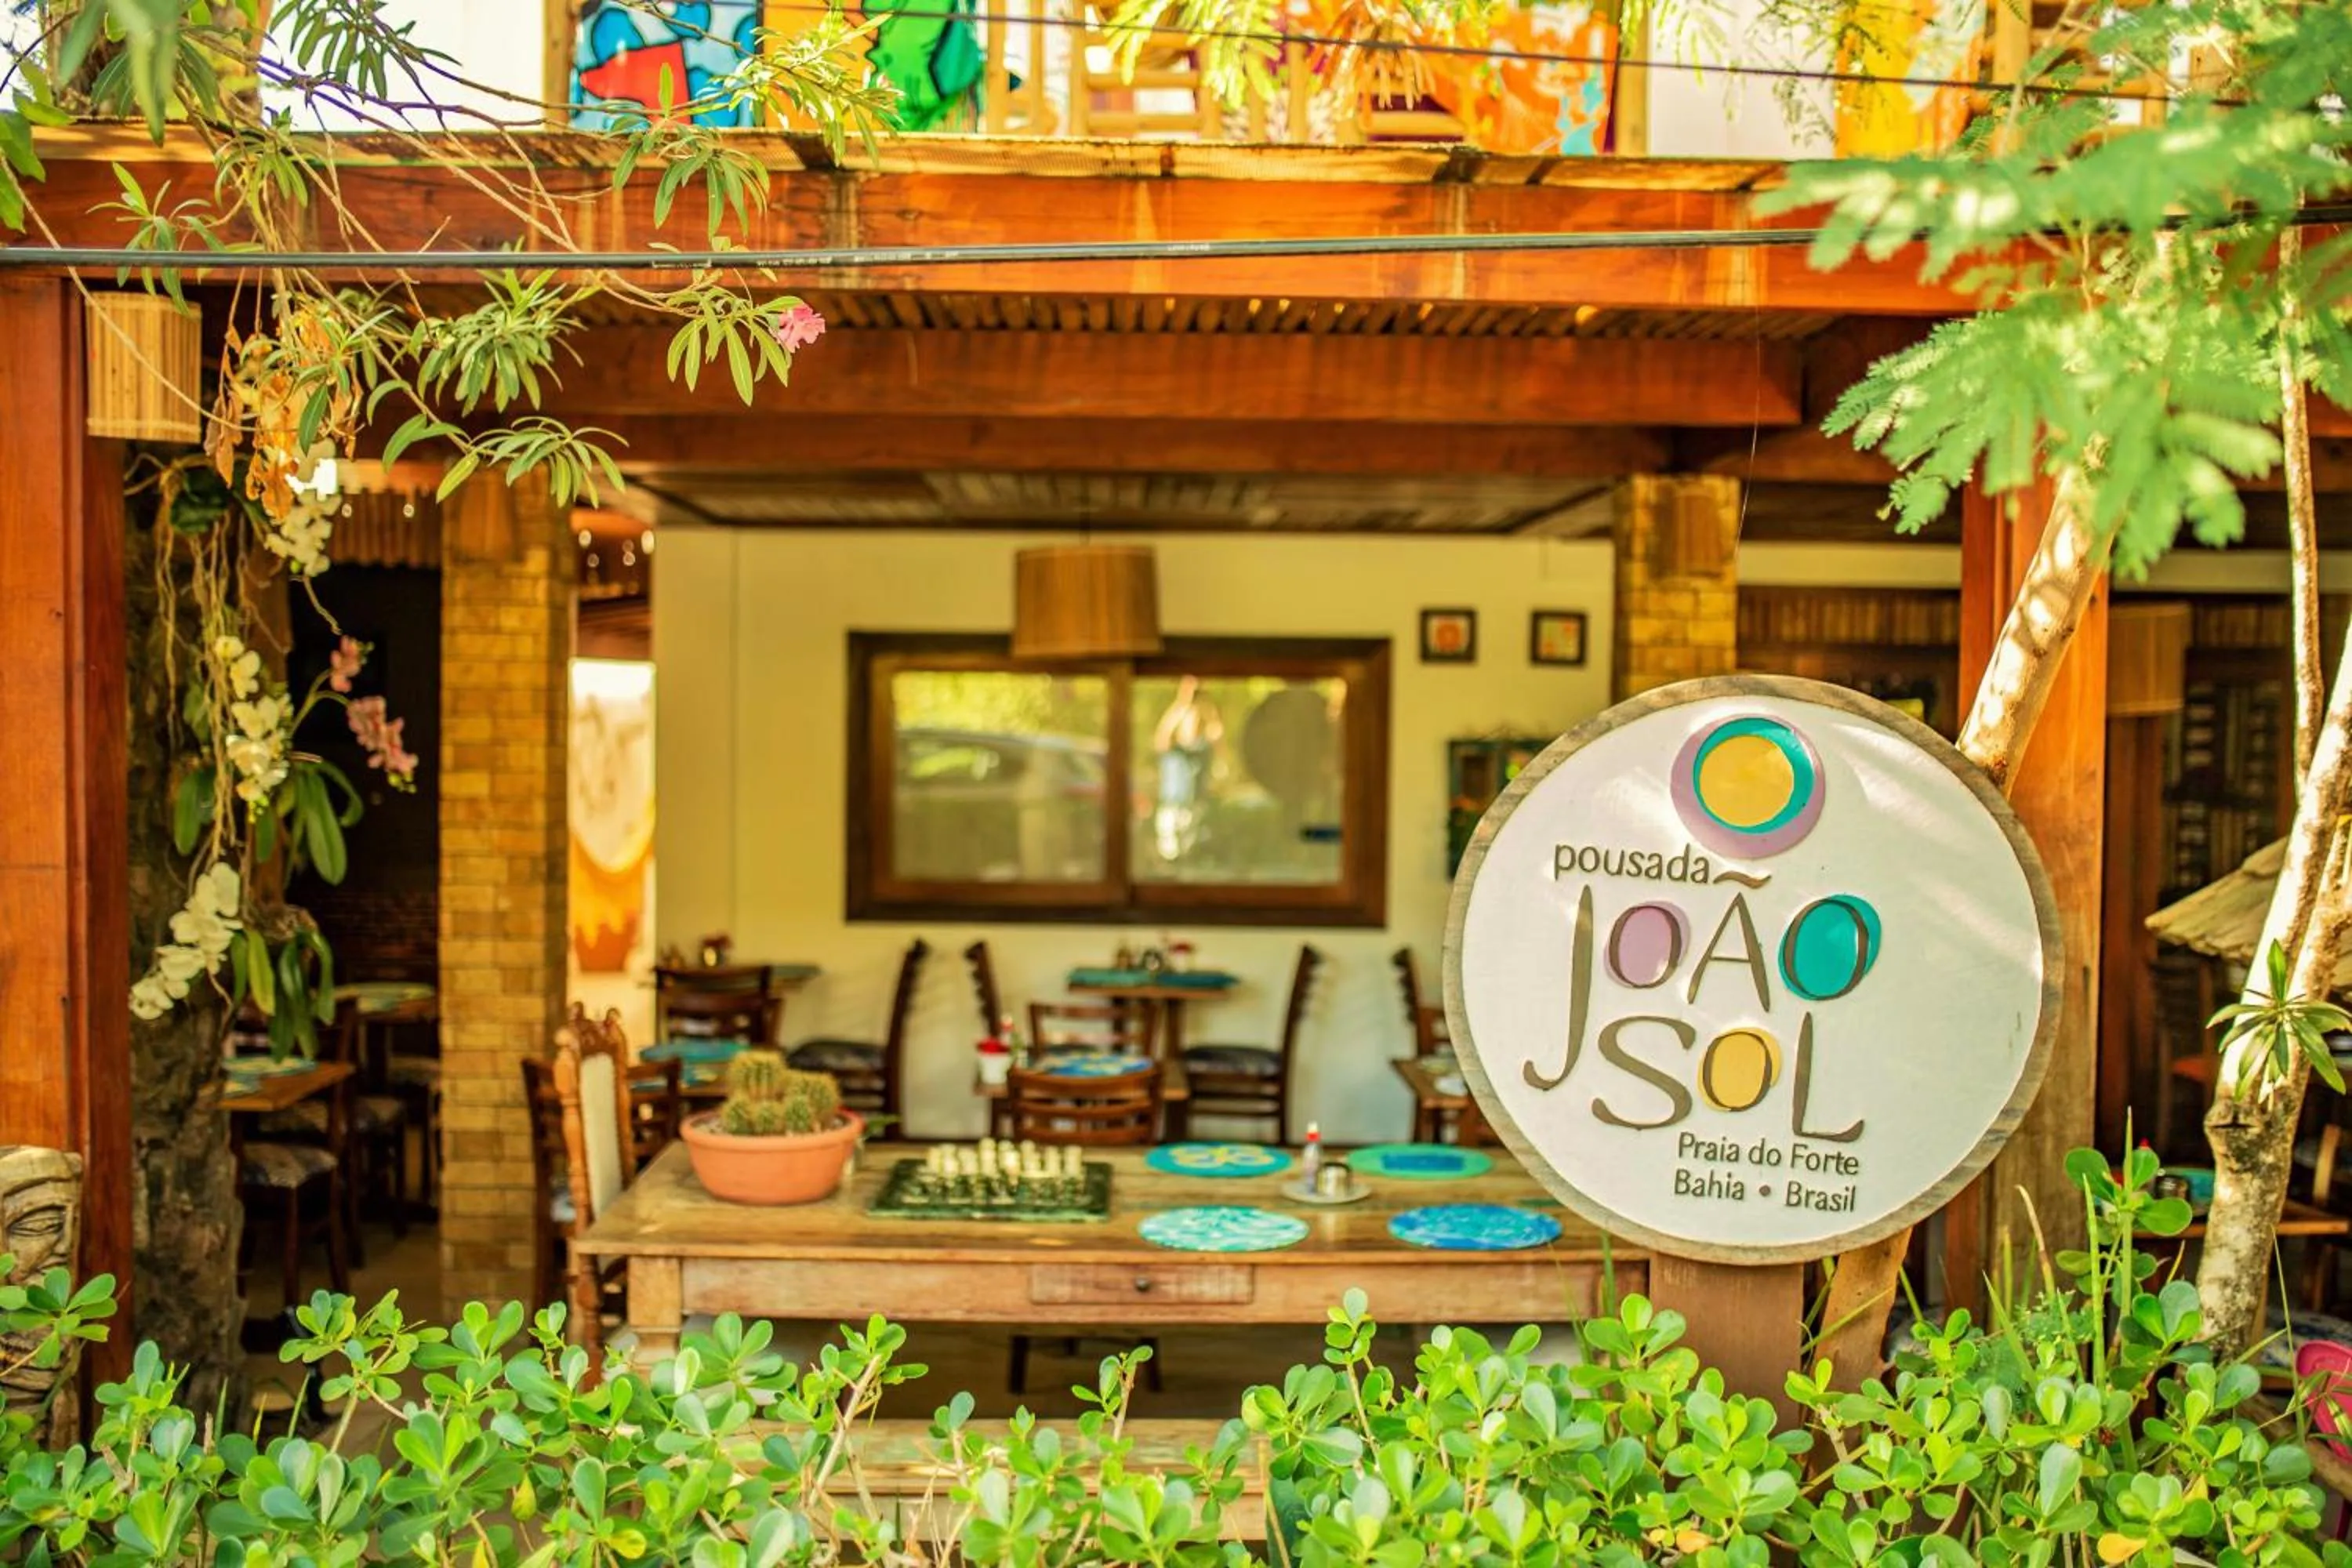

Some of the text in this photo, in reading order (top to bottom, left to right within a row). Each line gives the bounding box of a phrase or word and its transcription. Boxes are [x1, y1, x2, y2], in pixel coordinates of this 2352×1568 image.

[1555, 844, 1711, 884] pousada
[1592, 1011, 1864, 1143] SOL
[1678, 1131, 1859, 1175] Praia do Forte
[1674, 1169, 1857, 1213] Bahia Brasil
